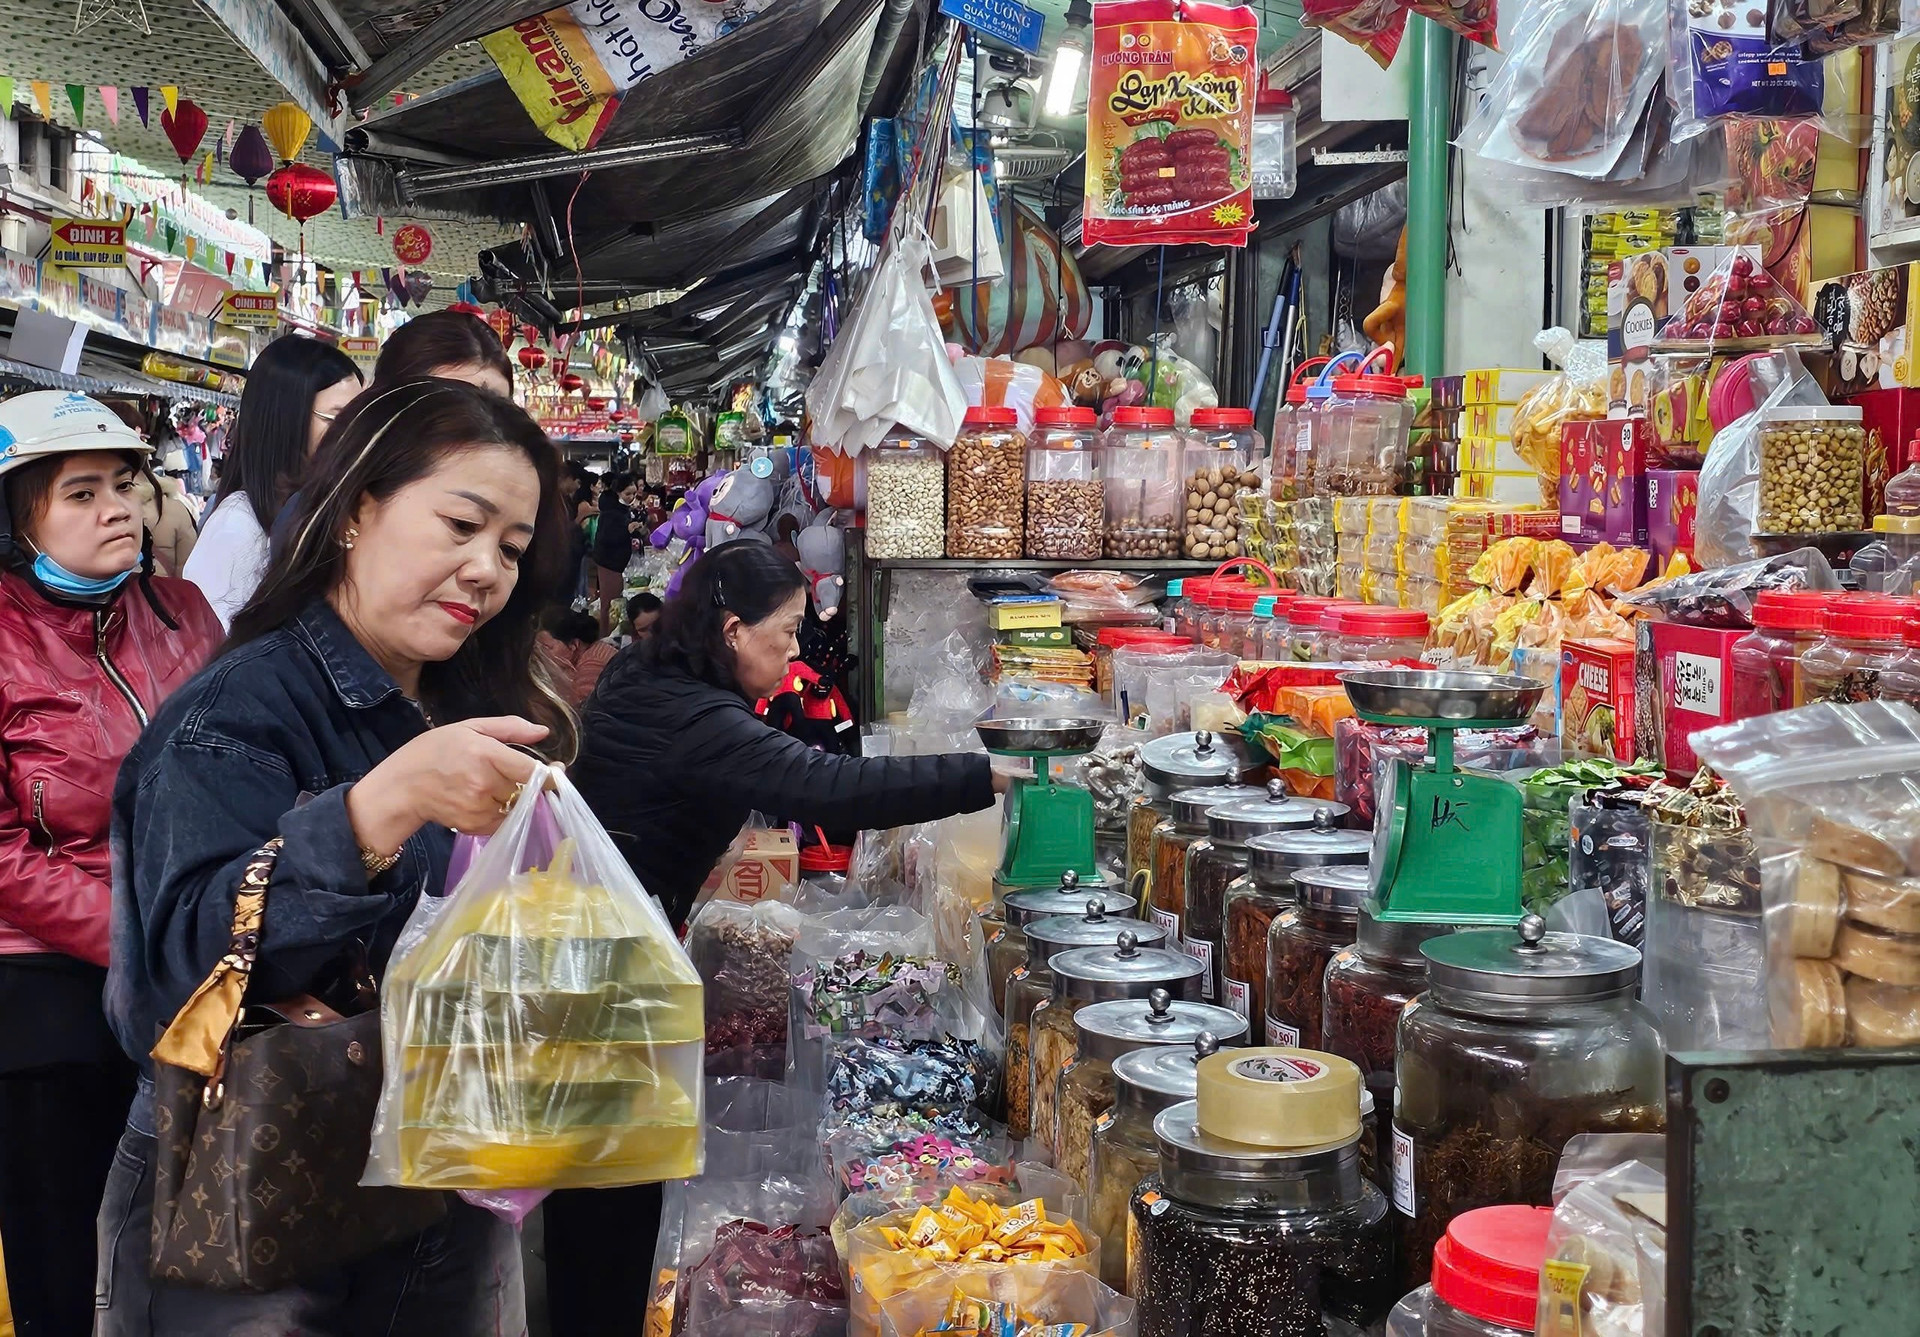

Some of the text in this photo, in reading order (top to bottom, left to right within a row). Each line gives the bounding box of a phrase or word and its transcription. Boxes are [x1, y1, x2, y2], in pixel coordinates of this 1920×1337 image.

[1111, 73, 1167, 112] Lạp
[110, 230, 119, 244] 2
[1625, 318, 1653, 334] COOKIES
[1623, 428, 1631, 441] 30
[1579, 662, 1609, 694] CHEESE
[734, 861, 764, 899] RITZ
